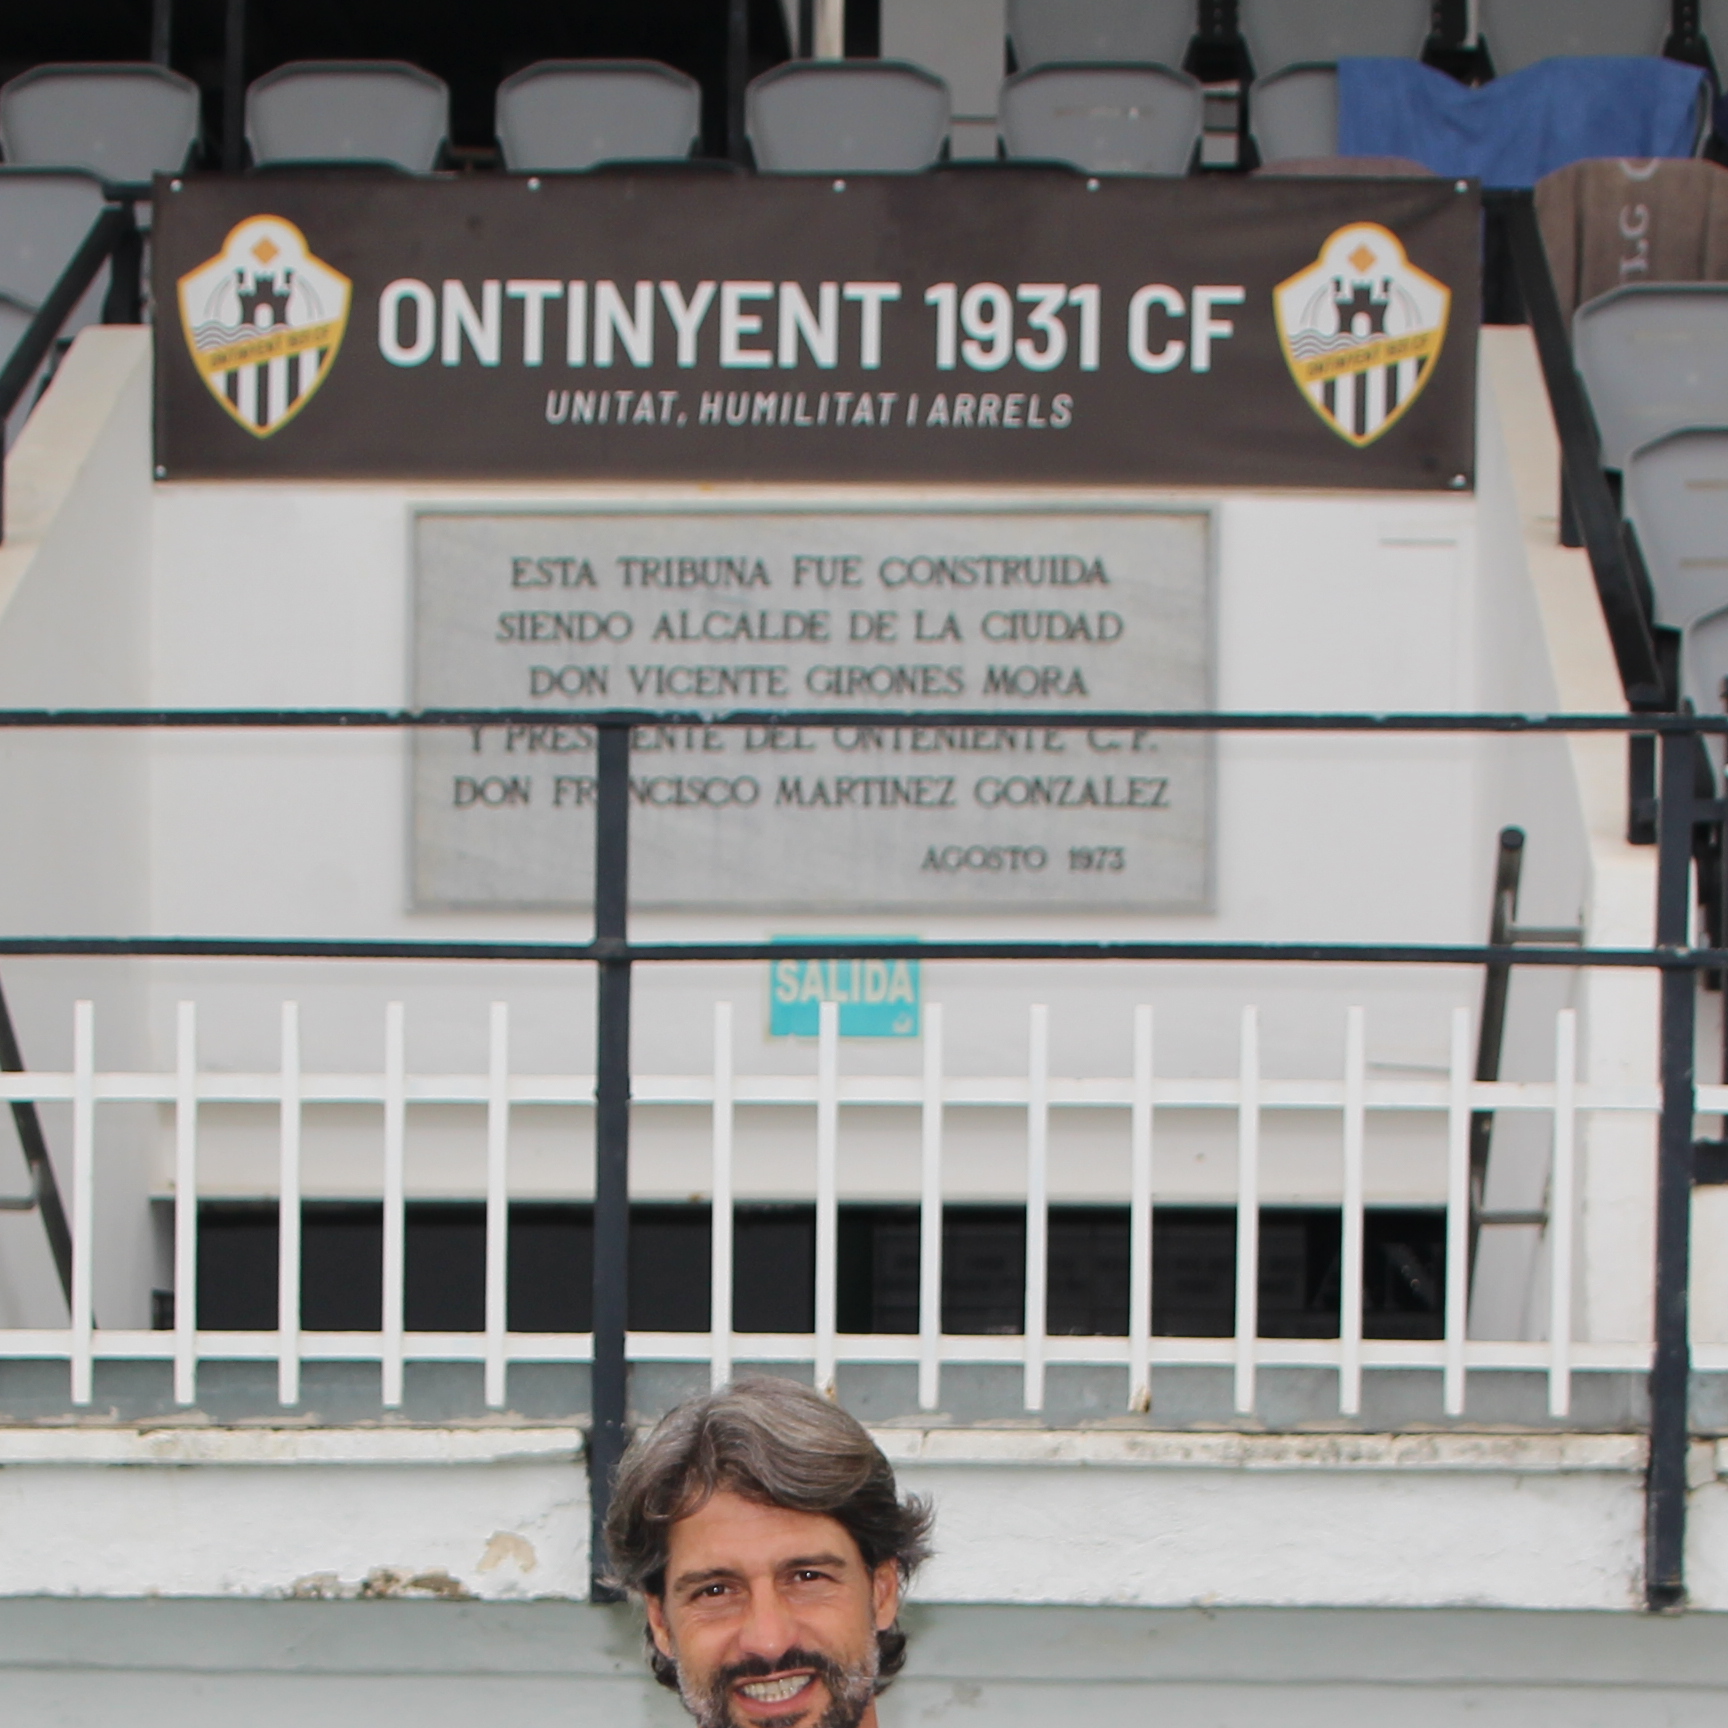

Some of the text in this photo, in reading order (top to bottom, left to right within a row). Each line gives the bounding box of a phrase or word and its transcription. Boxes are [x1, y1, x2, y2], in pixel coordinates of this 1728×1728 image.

[378, 278, 901, 369] ONTINYENT
[924, 282, 1100, 372] 1931
[1128, 283, 1246, 374] CF
[545, 389, 1074, 429] UNITAT, HUMILITAT I ARRELS
[511, 555, 1110, 588] ESTA TRIBUNA FUE CONSTRUIDA
[496, 609, 1125, 642] SIENDO ALCALDE DE LA CIUDAD
[529, 664, 1089, 696] DON VICENTE GIRONES MORA
[506, 724, 725, 752] PRESENTE
[744, 725, 815, 752] DEL
[832, 725, 1066, 752] ONTENIENTE
[453, 774, 1170, 808] DON FRNCISCO MARTINEZ GONZALEZ
[921, 844, 1126, 872] AGOSTO 1973
[776, 958, 915, 1004] SALIDA
